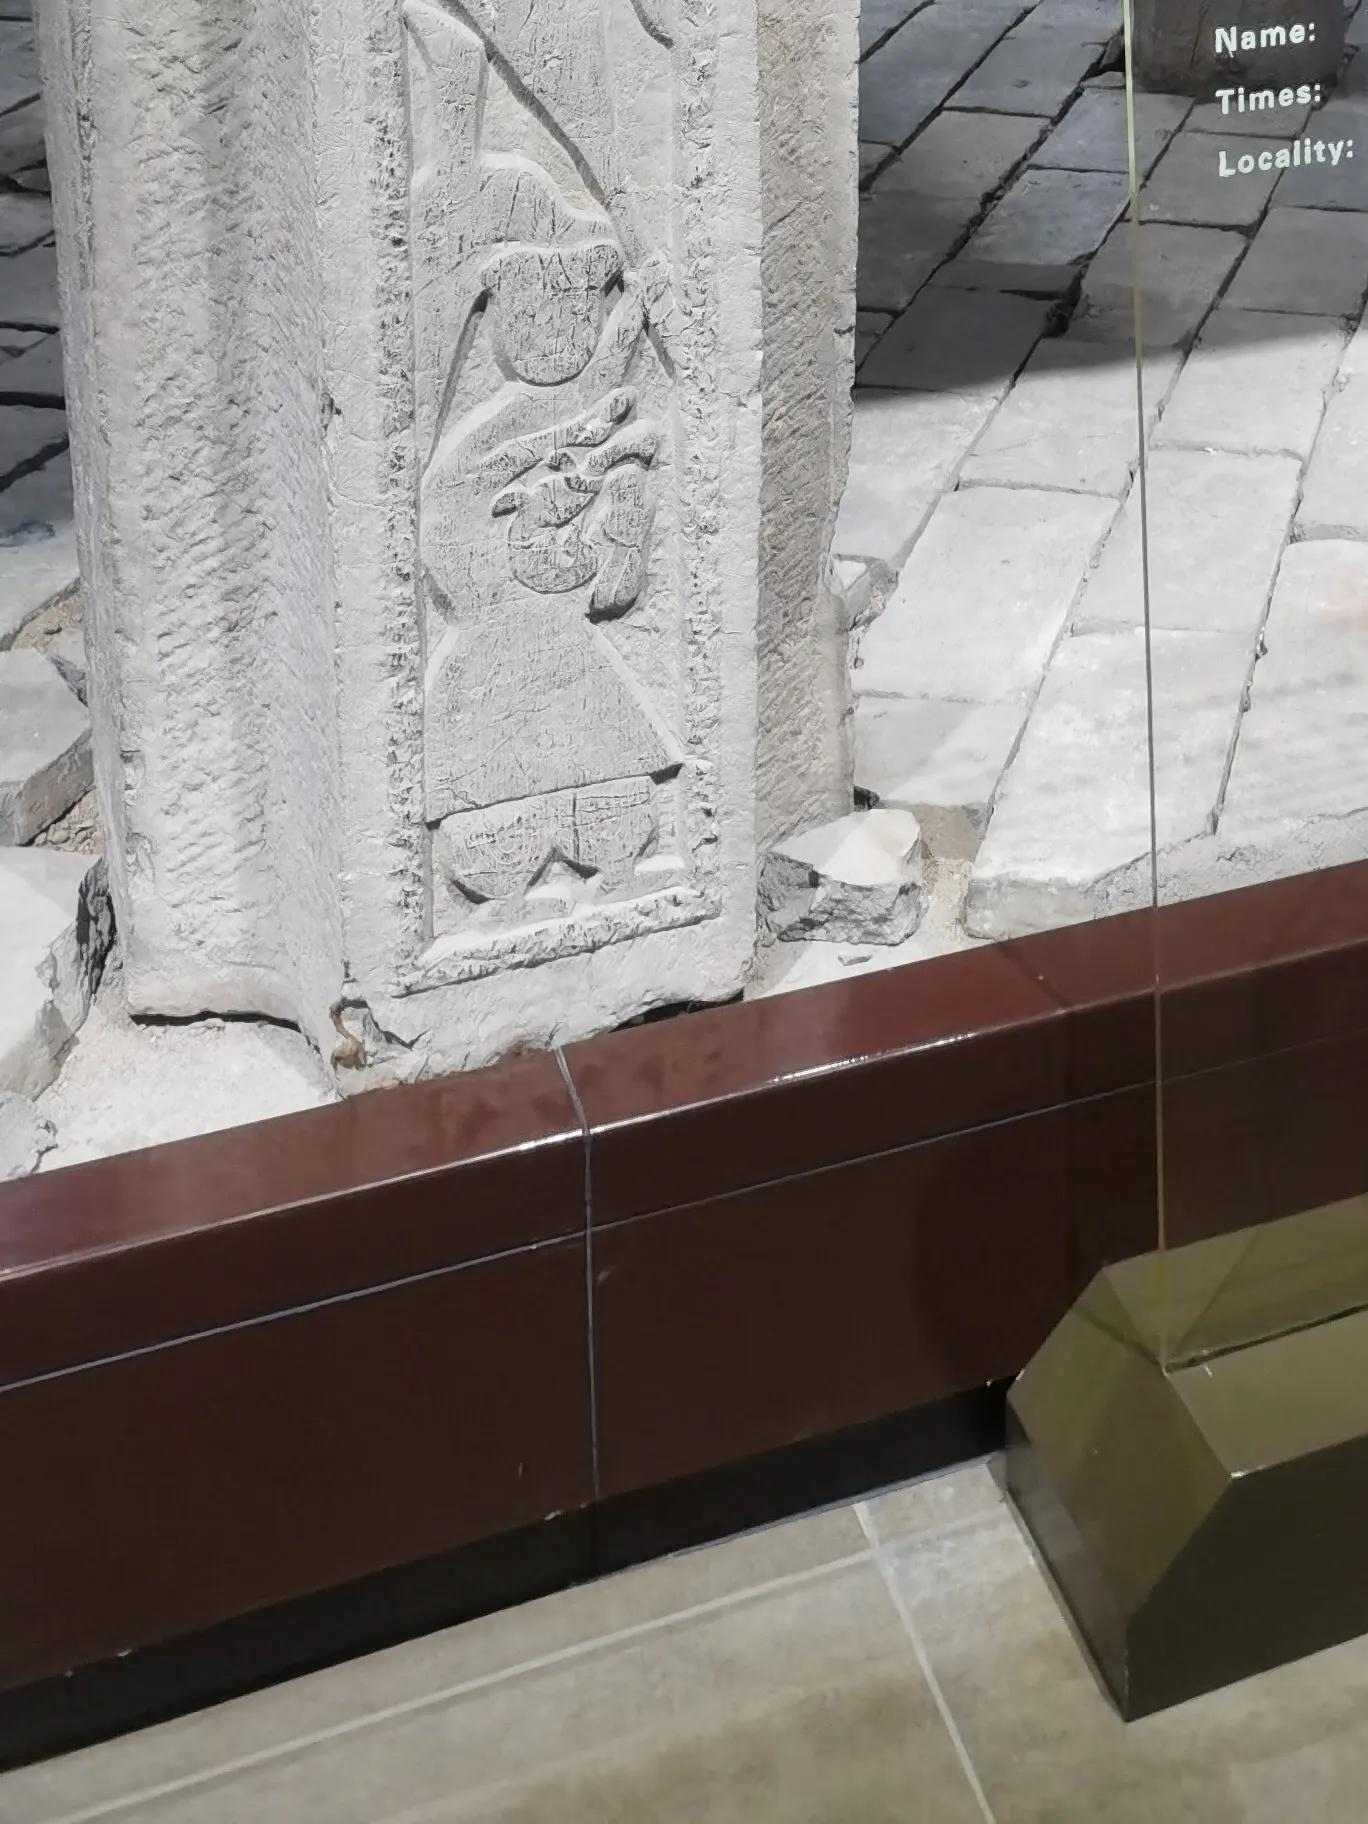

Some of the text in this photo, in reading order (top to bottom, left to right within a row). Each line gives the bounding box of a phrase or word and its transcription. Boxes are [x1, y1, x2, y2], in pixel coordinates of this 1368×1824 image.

[1214, 22, 1316, 55] Name:
[1214, 83, 1322, 116] Times:
[1217, 137, 1355, 178] Locality:
